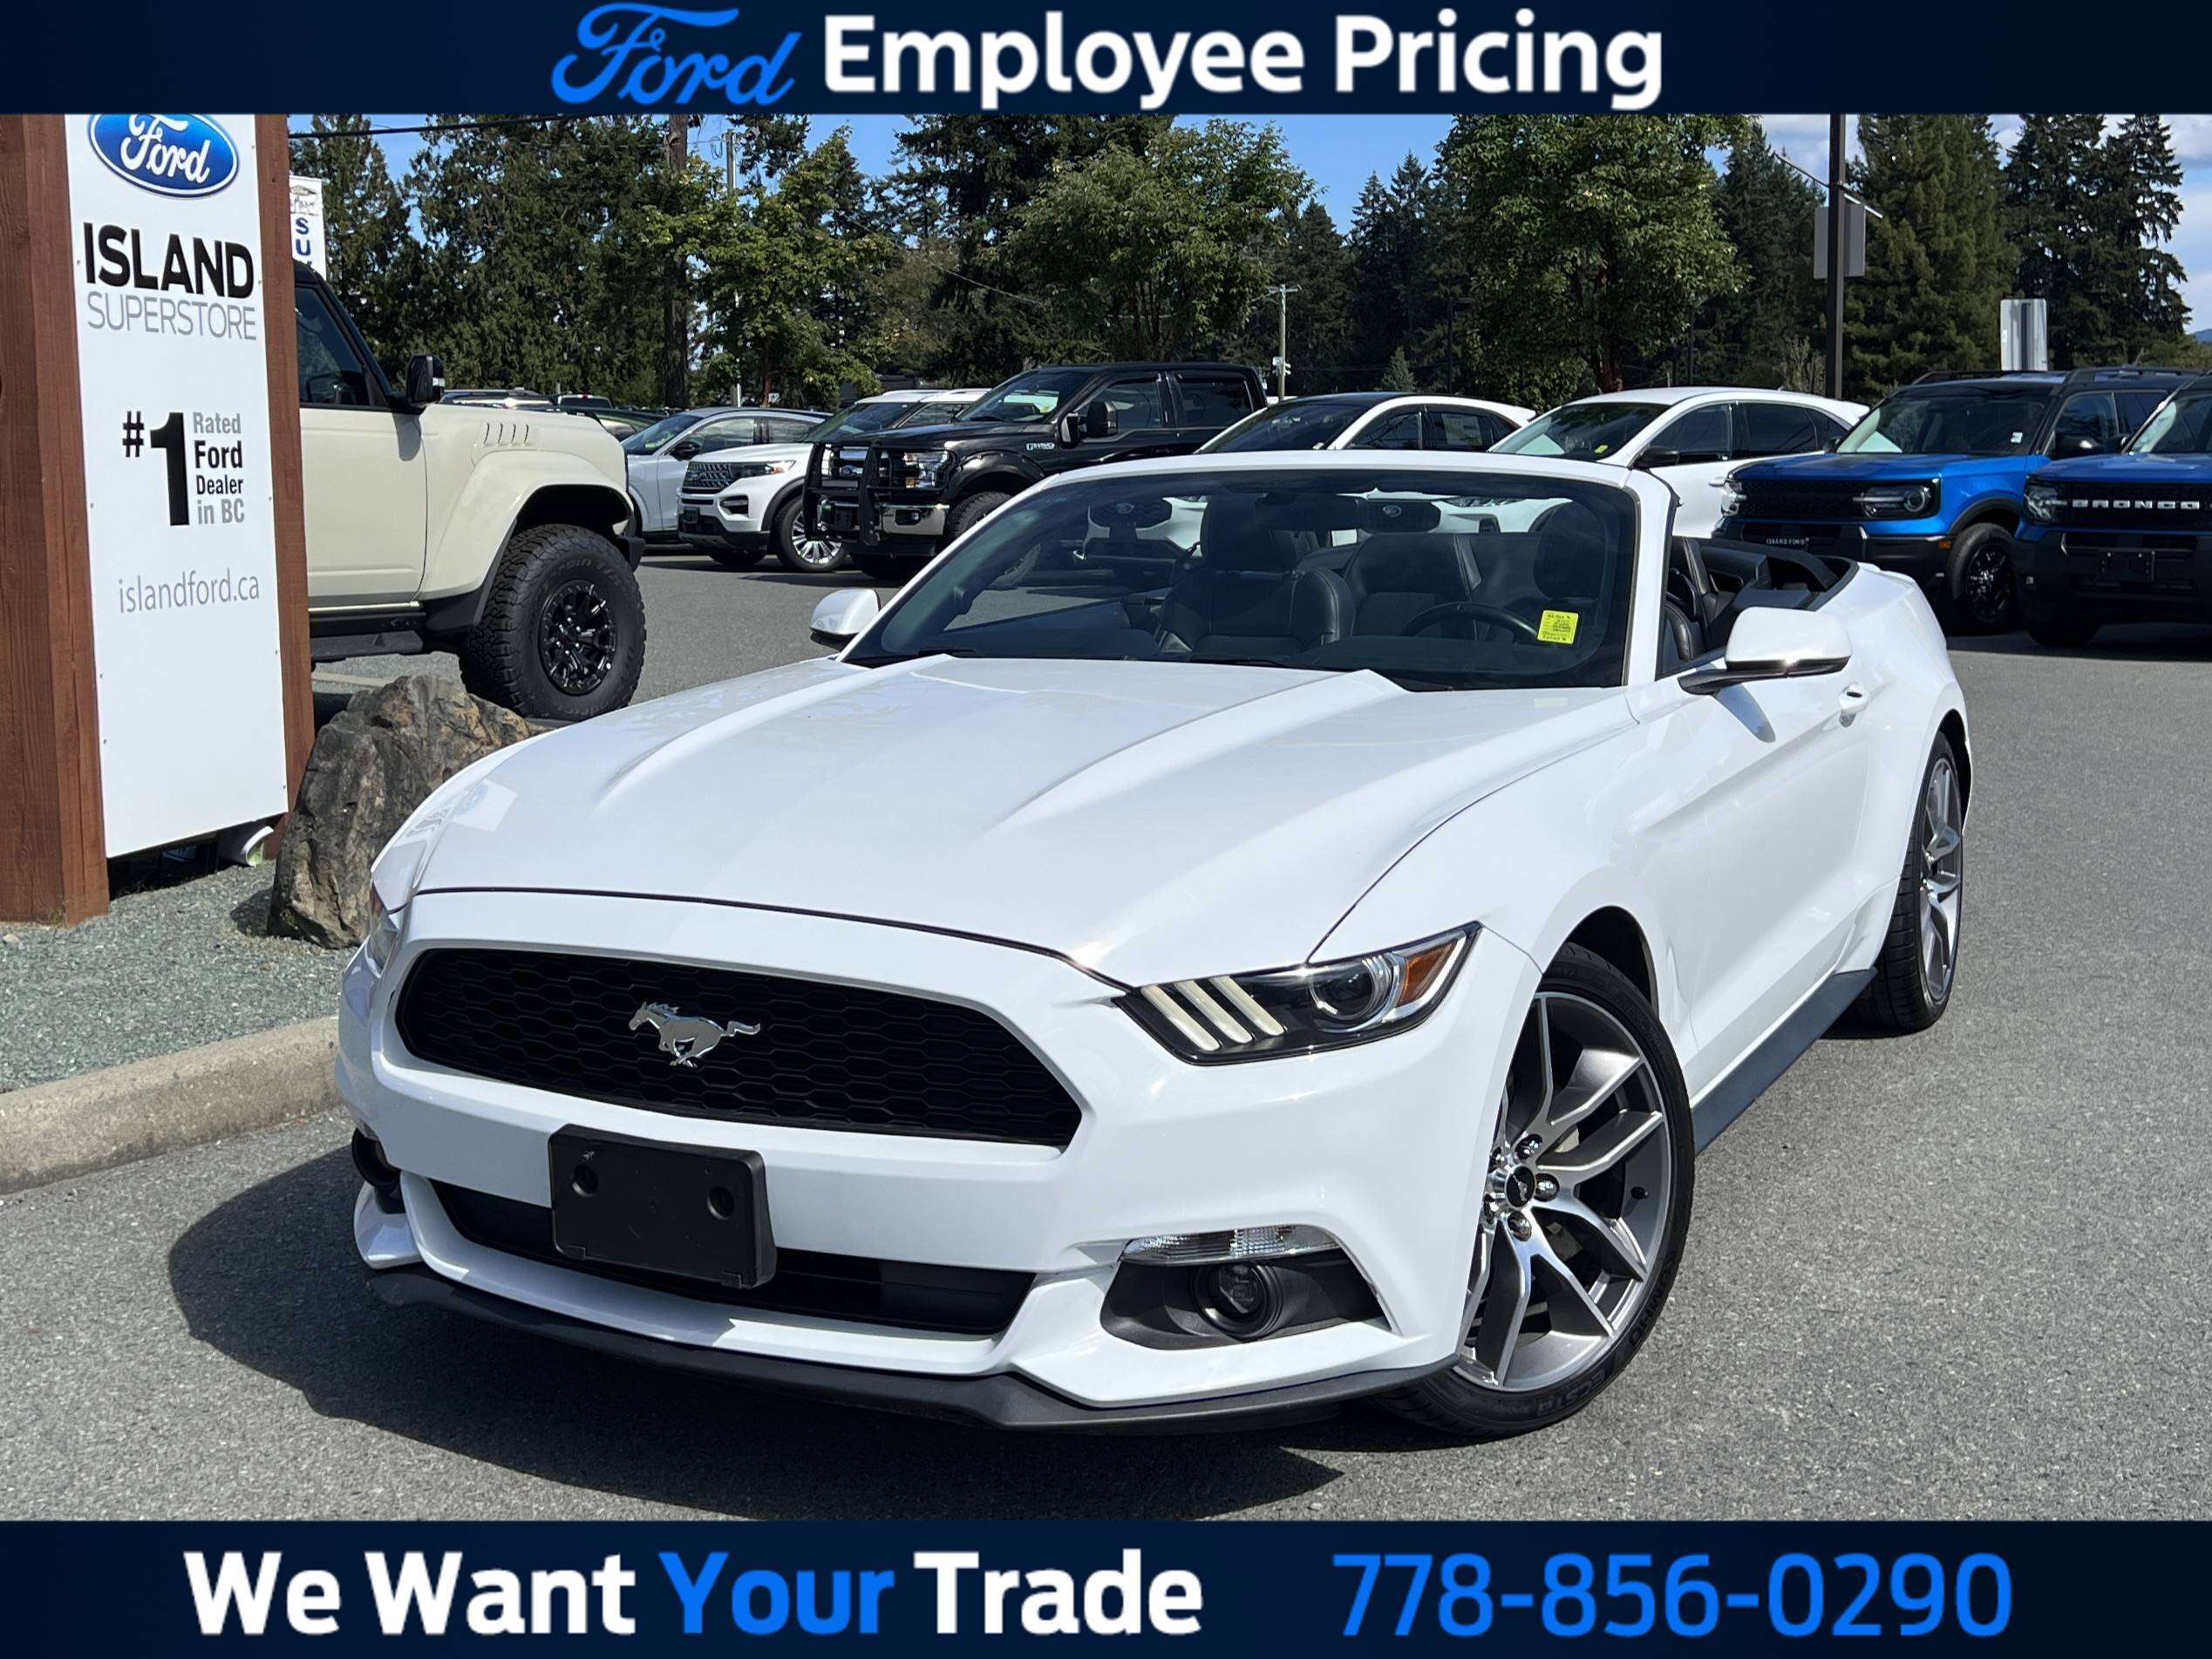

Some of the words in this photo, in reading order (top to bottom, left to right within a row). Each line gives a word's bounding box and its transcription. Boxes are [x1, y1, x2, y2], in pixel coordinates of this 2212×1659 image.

[120, 114, 212, 184] Ford
[83, 221, 255, 299] ISLAND
[295, 216, 312, 267] SU
[86, 290, 257, 341] SUPERSTORE
[193, 411, 242, 435] Rated
[194, 439, 244, 469] Ford
[195, 473, 244, 495] Dealer
[197, 499, 215, 525] in
[221, 498, 246, 524] BC
[2072, 499, 2201, 511] BRONCO
[118, 568, 261, 614] islandford.ca
